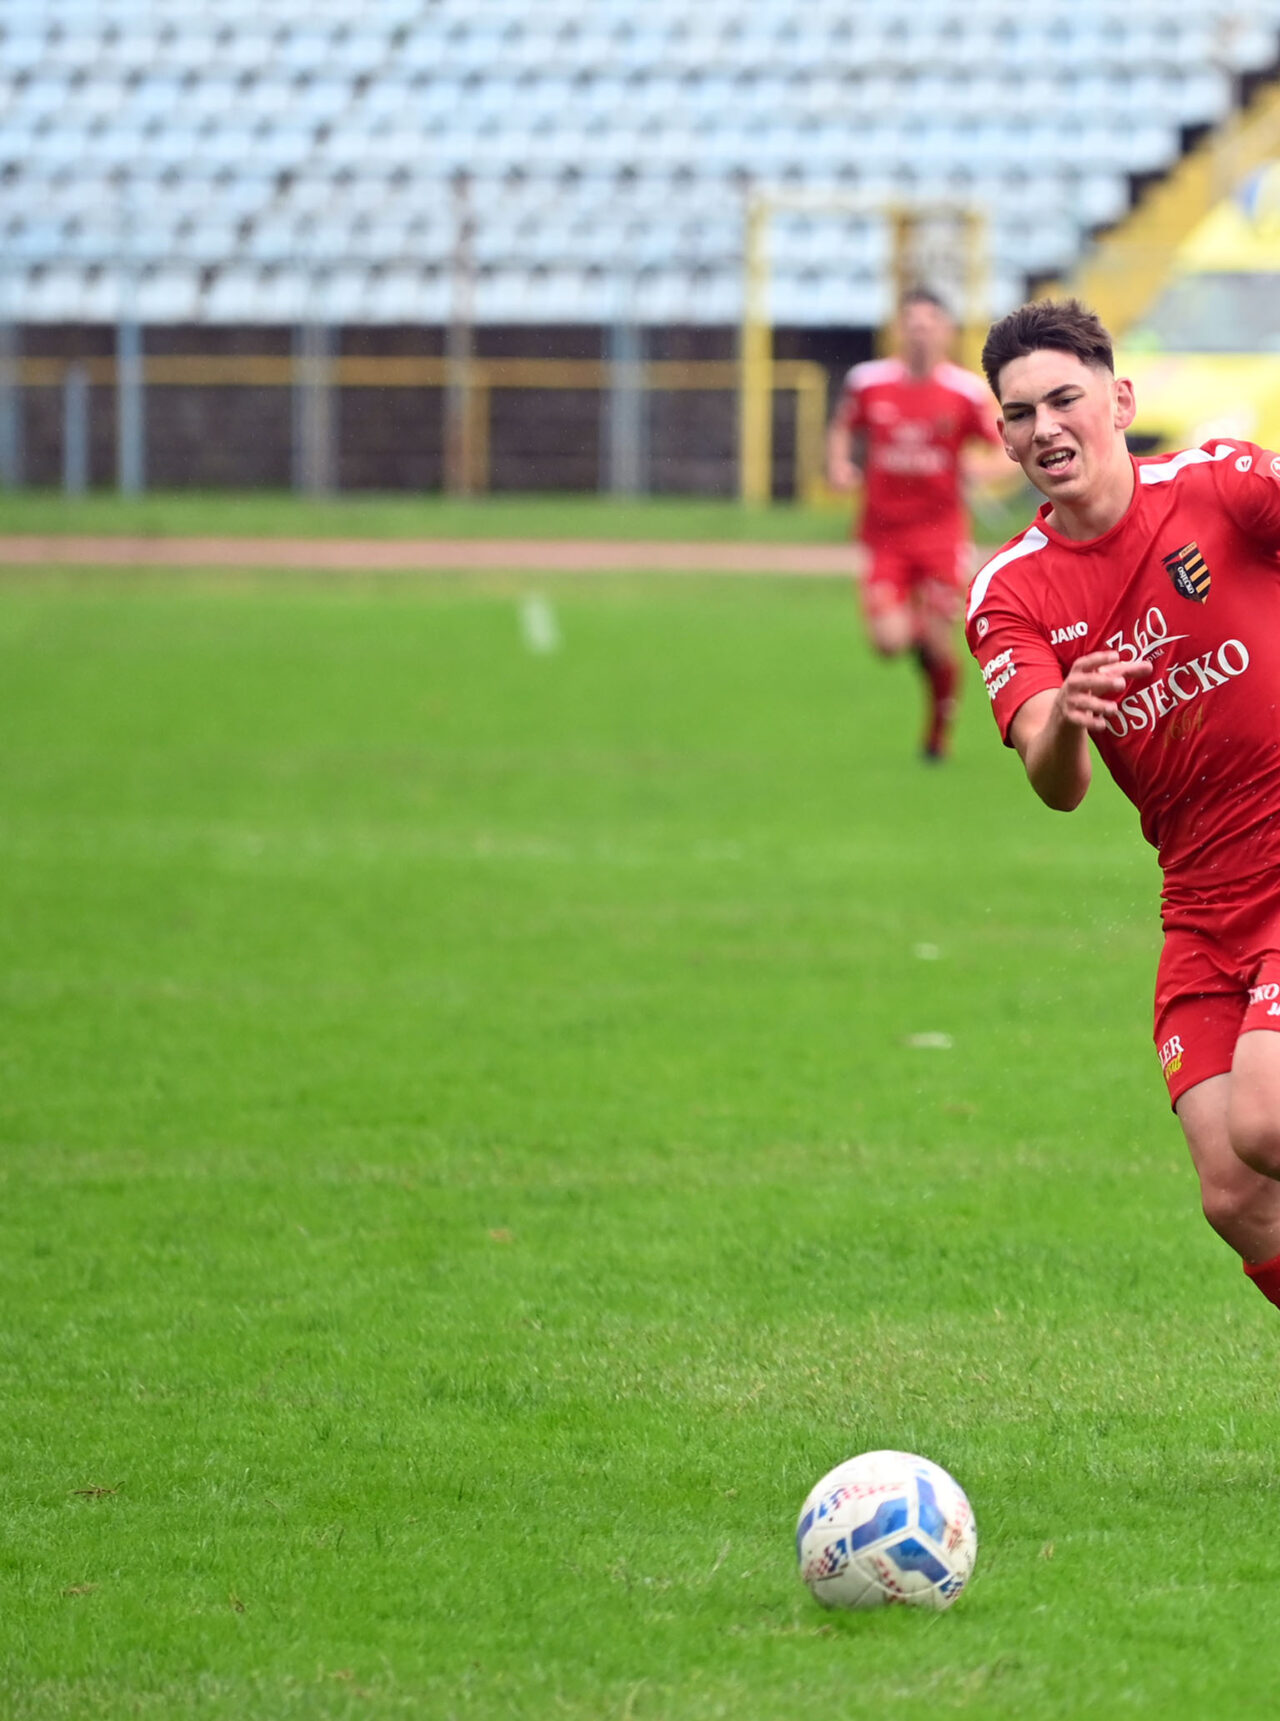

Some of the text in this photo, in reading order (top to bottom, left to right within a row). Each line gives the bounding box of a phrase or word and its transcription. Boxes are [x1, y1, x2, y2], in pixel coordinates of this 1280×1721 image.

[1050, 621, 1088, 645] JAKO
[1106, 607, 1167, 663] 360
[1103, 639, 1250, 738] OSJEČKO
